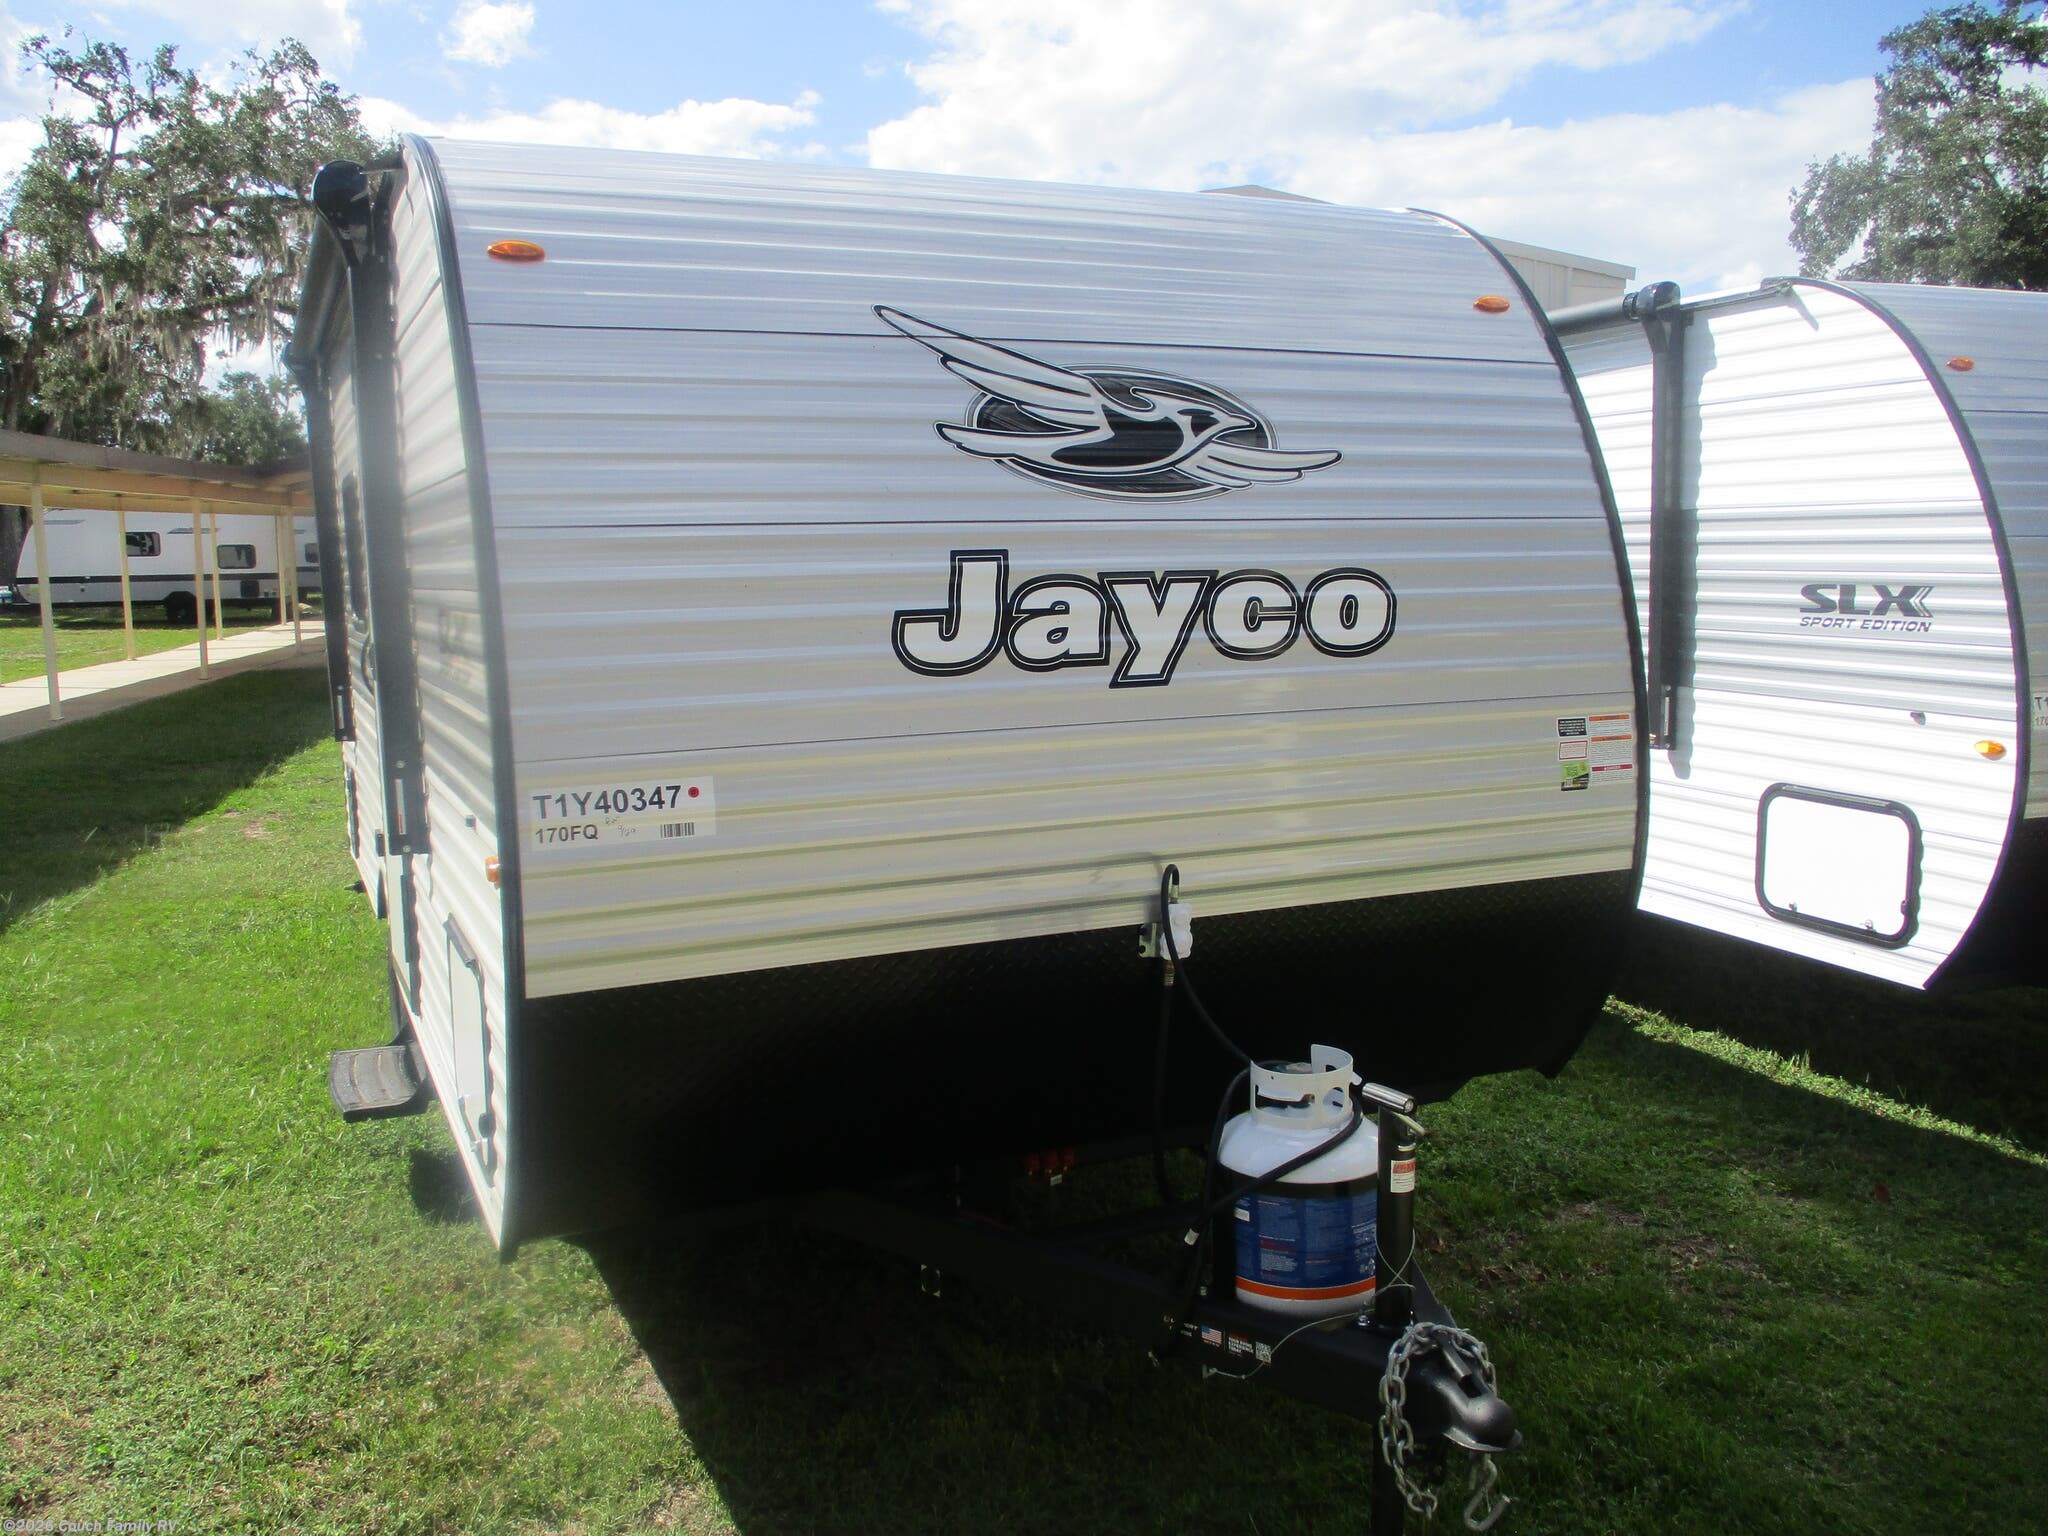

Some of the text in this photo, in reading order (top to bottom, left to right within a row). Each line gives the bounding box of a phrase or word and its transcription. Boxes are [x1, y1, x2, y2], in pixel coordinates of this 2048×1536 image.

[1800, 584, 1934, 618] SLX
[891, 549, 1397, 688] Jayco
[1800, 616, 1932, 633] SPORT EDITION
[532, 785, 681, 819] T1Y40347
[535, 824, 598, 844] 170FQ
